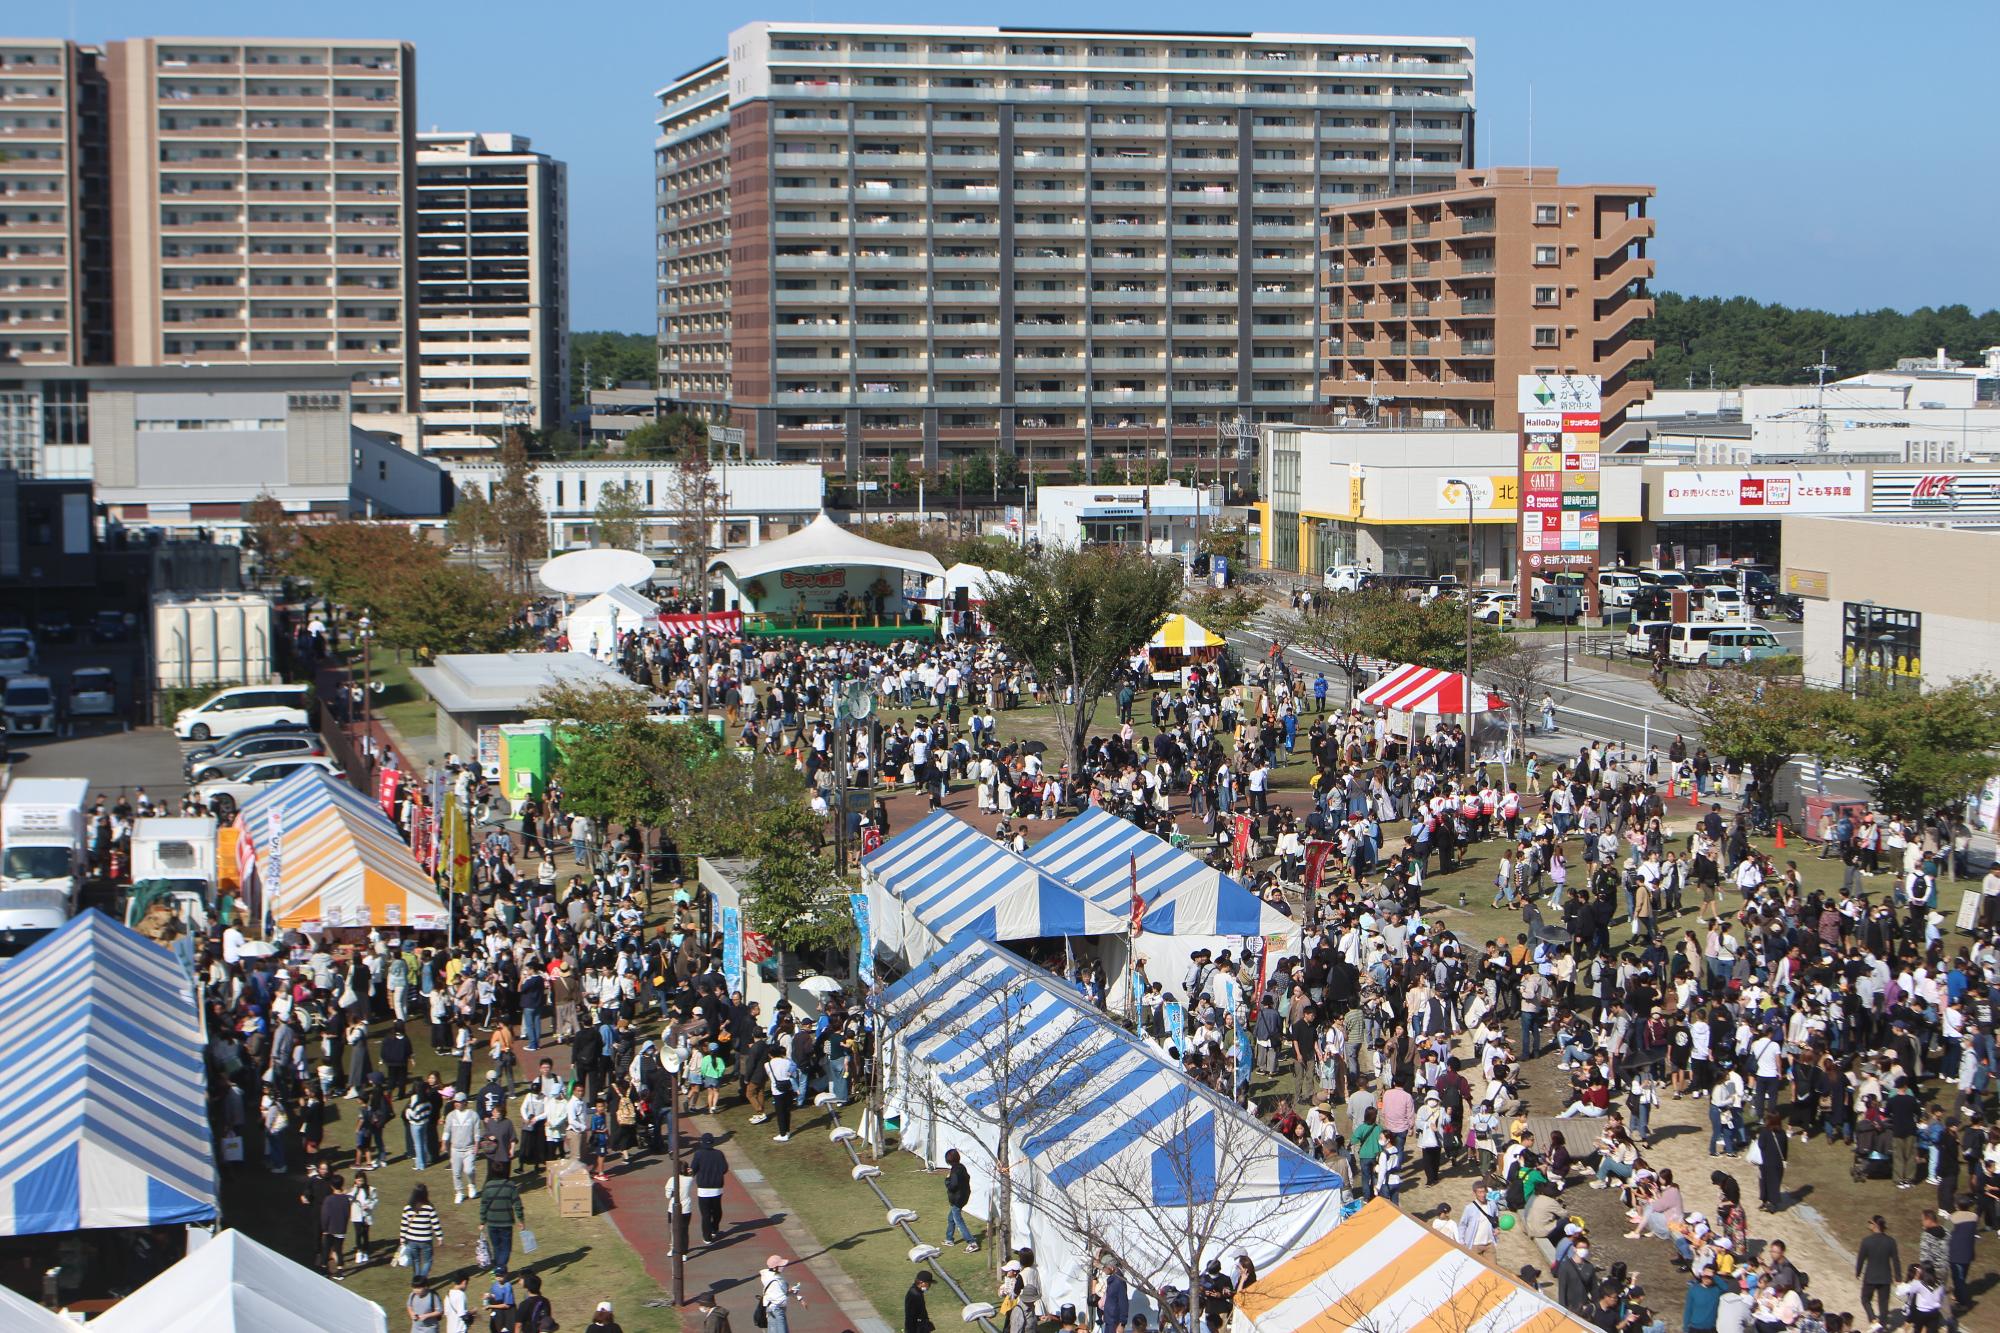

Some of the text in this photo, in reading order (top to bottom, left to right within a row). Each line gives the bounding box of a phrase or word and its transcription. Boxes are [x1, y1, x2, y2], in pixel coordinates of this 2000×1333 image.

[1526, 419, 1560, 427] HalloDay
[1531, 434, 1556, 443] Seria
[1532, 455, 1553, 466] MK
[1530, 474, 1555, 488] EARTH
[1682, 488, 1734, 498] お売りください
[1798, 486, 1852, 497] こども写真館
[1563, 495, 1597, 505] 眼鏡市場
